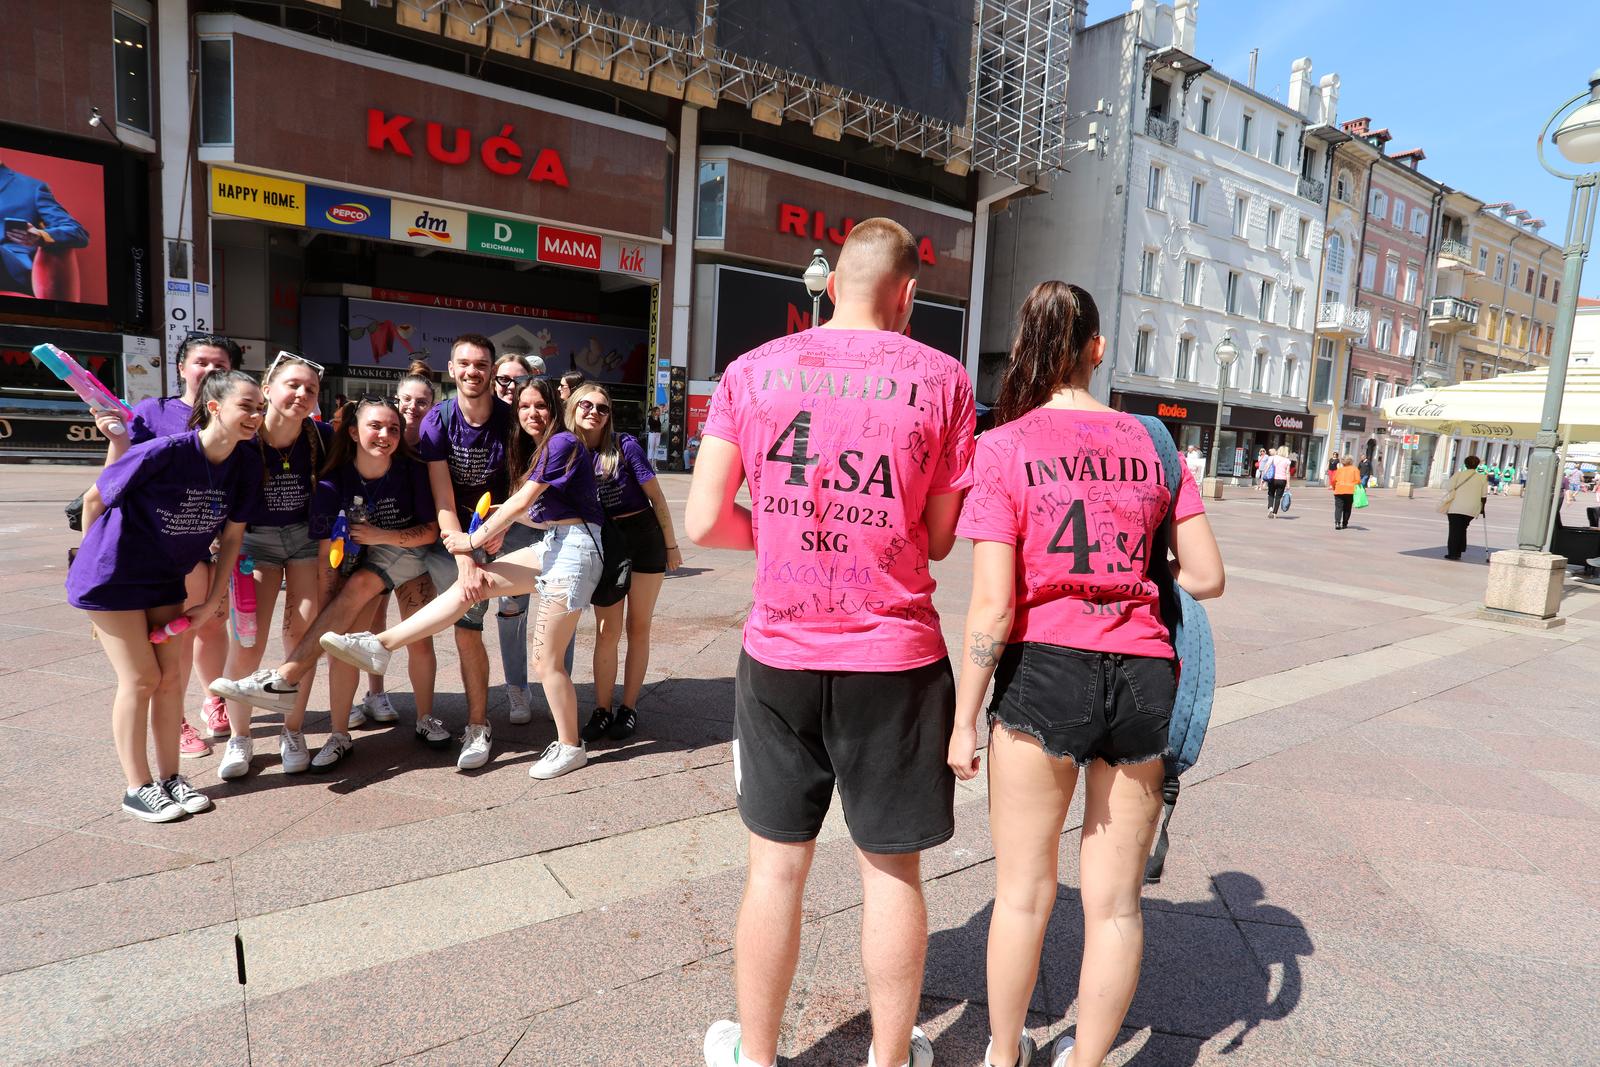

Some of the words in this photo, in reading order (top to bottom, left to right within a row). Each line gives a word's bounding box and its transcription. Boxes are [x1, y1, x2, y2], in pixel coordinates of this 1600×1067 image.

[367, 108, 570, 188] KUĆA
[218, 183, 258, 202] HAPPY
[263, 190, 299, 209] HOME.
[332, 207, 365, 221] PEPCO
[415, 211, 447, 232] dm
[494, 222, 512, 243] D
[779, 203, 936, 265] RIJA
[481, 242, 524, 254] DEICHMANN
[545, 236, 597, 259] MANA
[433, 297, 508, 313] AUTOMAT
[513, 306, 549, 318] CLUB
[197, 318, 209, 331] 2.
[347, 368, 392, 378] MASKICE
[761, 368, 898, 401] INVALID
[1158, 403, 1188, 419] Rodea
[766, 410, 896, 499] 4.SA
[1024, 455, 1148, 487] INVALID
[800, 531, 848, 554] SKG
